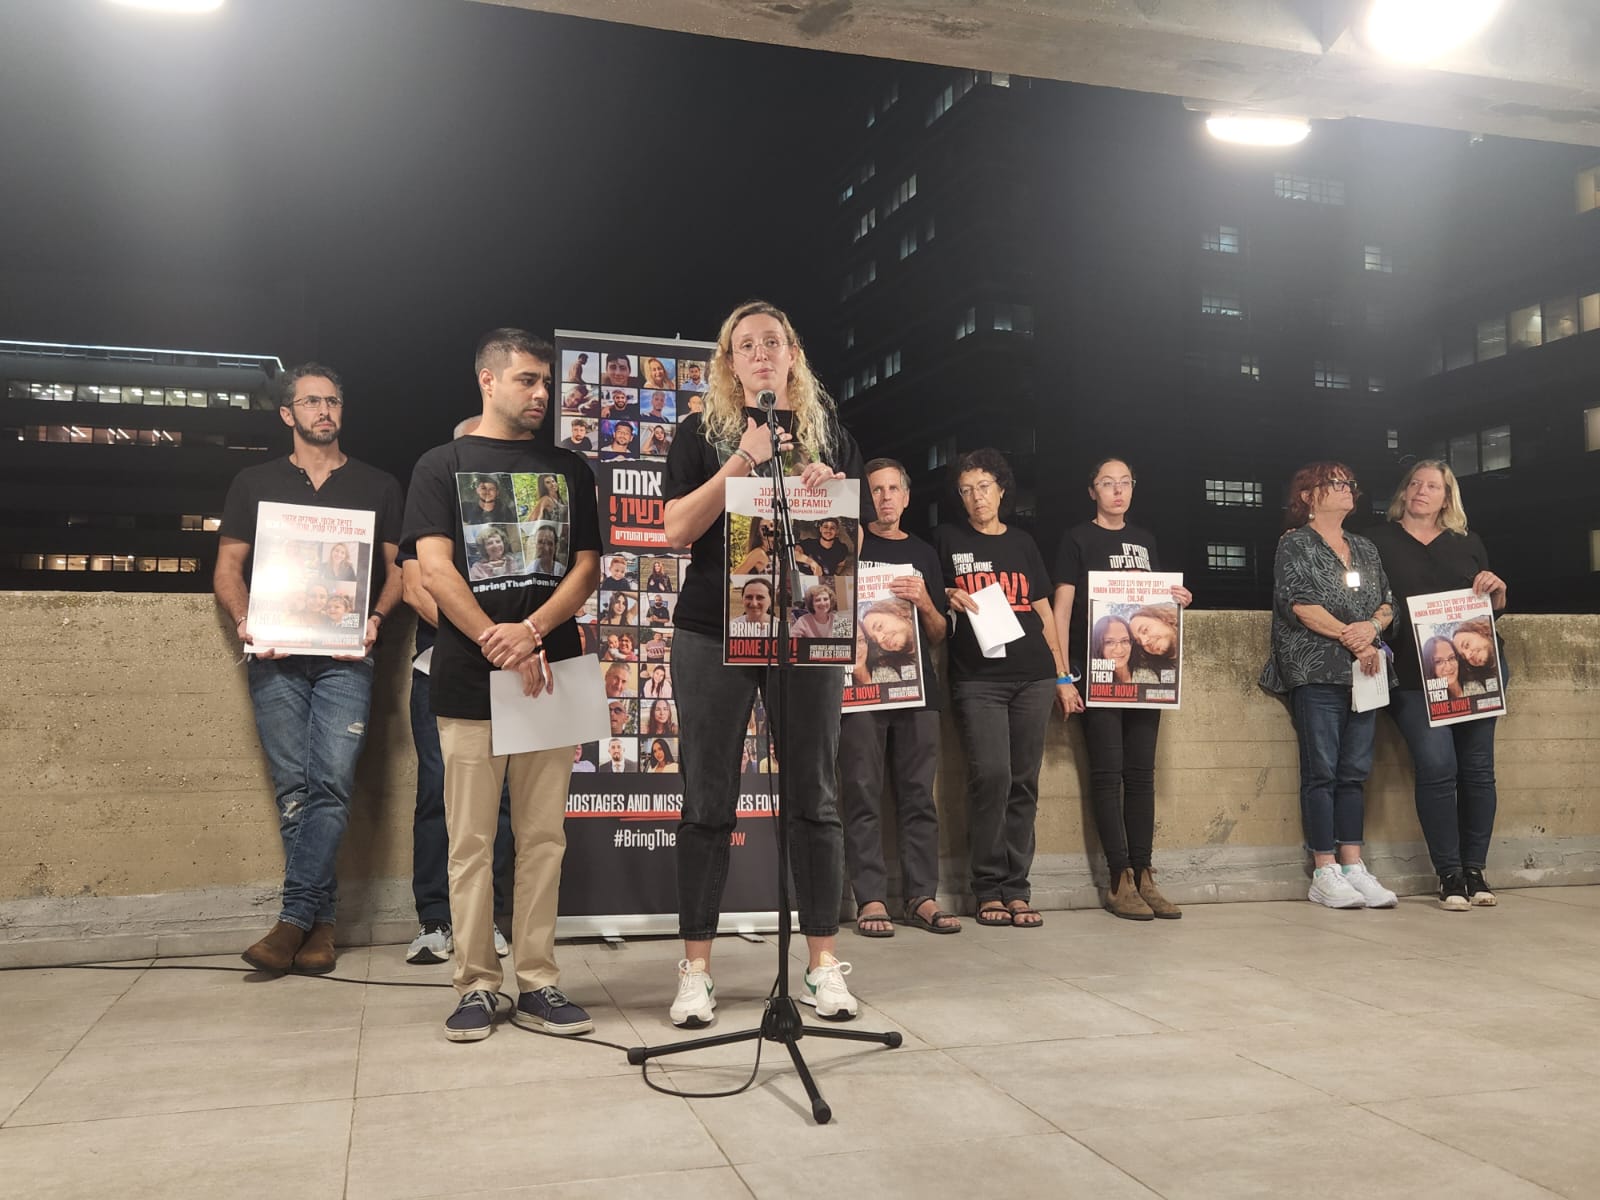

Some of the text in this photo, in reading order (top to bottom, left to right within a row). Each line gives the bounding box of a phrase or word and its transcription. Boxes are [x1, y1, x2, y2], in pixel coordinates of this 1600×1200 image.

[612, 468, 662, 497] אותם
[794, 487, 828, 498] משפחת
[609, 495, 665, 525] כשיו!
[753, 498, 833, 508] TRUOB FAMILY
[952, 553, 974, 565] BRING
[1108, 555, 1135, 569] הביתה
[955, 561, 993, 575] THEM HOME
[729, 622, 761, 638] BRING
[729, 637, 798, 656] HOME NO!
[1091, 658, 1116, 671] BRING
[1091, 671, 1113, 683] THEM
[1427, 677, 1449, 691] BRING
[856, 684, 880, 700] NOW!
[1091, 684, 1113, 696] HOME
[1114, 684, 1138, 697] NOW!
[1428, 689, 1449, 703] THEM
[1431, 701, 1451, 715] HOME
[1451, 697, 1471, 713] NOW!
[565, 793, 625, 812] HOSTAGES
[627, 794, 650, 812] AND
[653, 794, 684, 812] MISS
